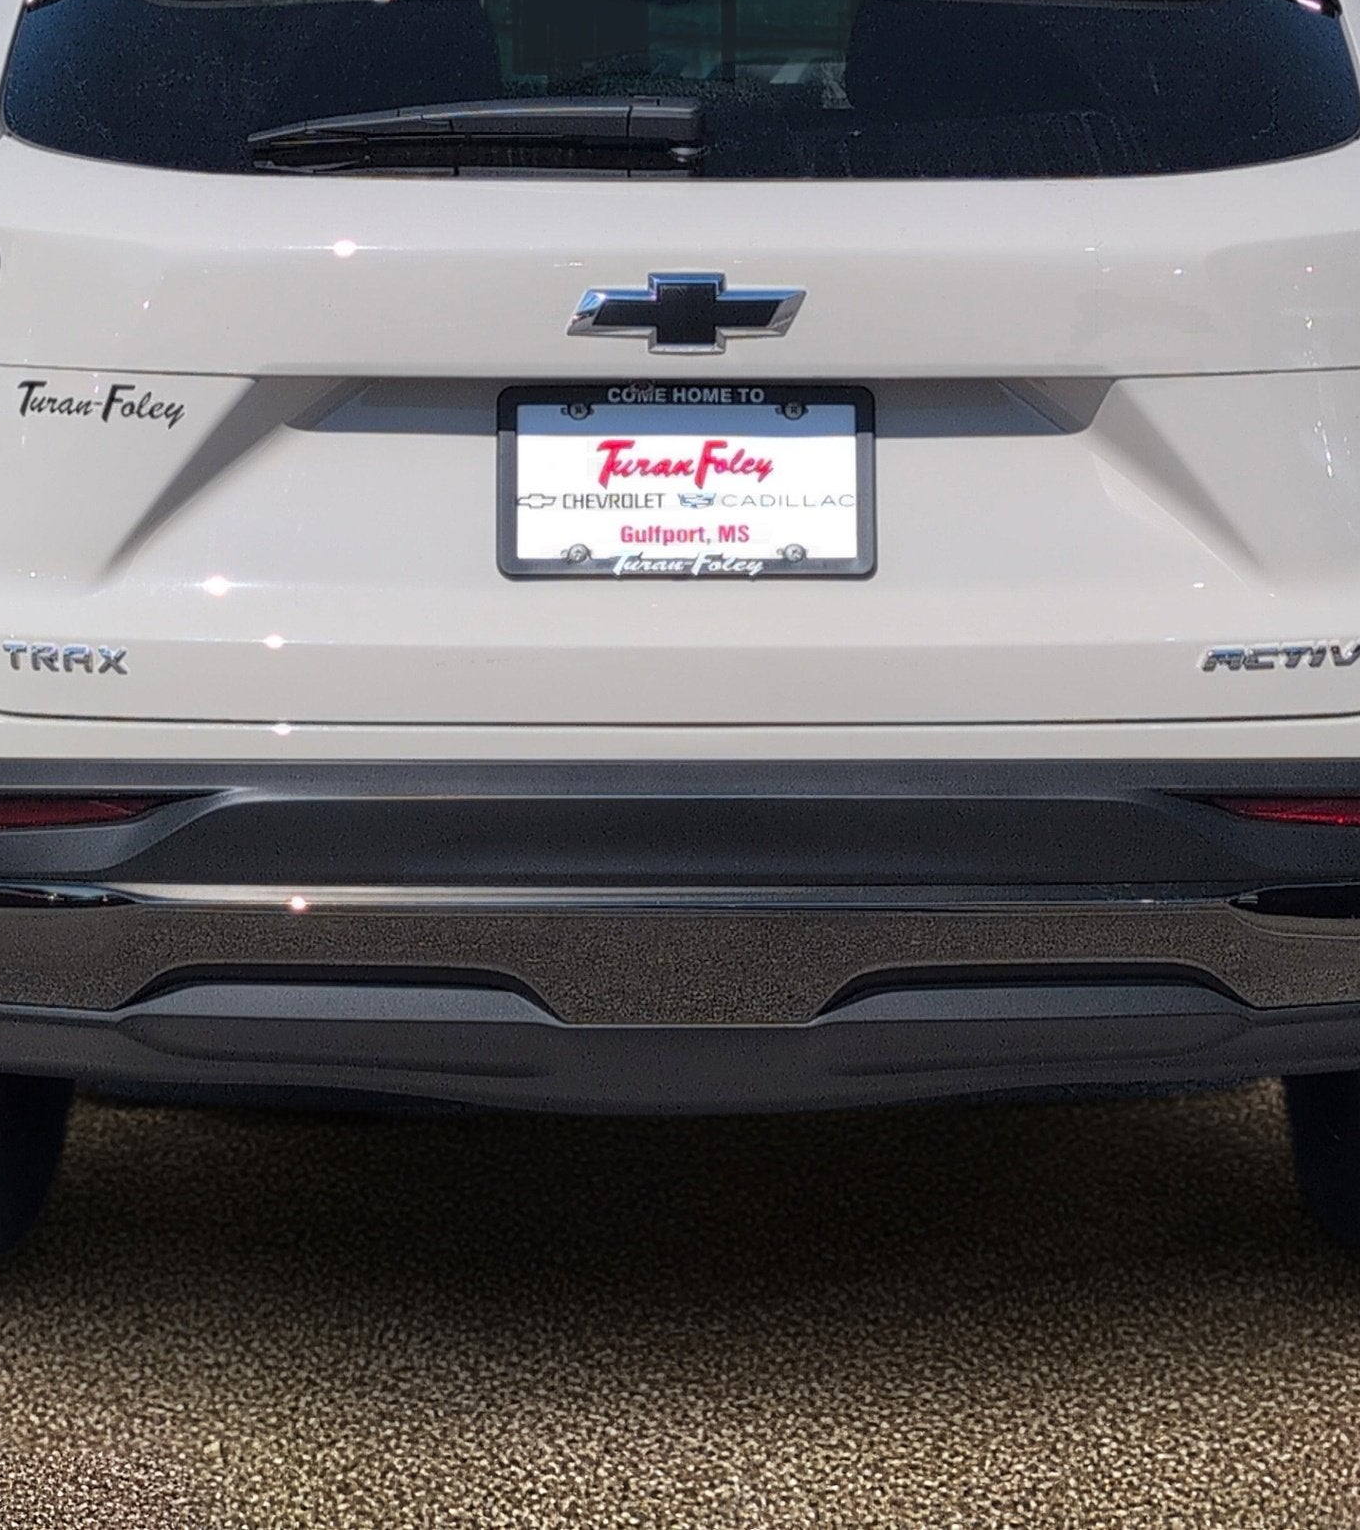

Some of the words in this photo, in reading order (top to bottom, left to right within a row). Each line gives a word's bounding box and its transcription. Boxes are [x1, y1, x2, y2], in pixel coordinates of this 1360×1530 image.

[607, 386, 667, 404] COME
[672, 386, 733, 404] HOME
[737, 386, 765, 403] TO
[596, 439, 694, 490] Turan
[693, 439, 774, 490] Foley
[562, 492, 667, 510] CHEVROLET
[720, 492, 856, 508] CADILLAC
[620, 525, 712, 546] Gulfport,
[718, 525, 751, 543] MS
[2, 640, 128, 675] TRAX
